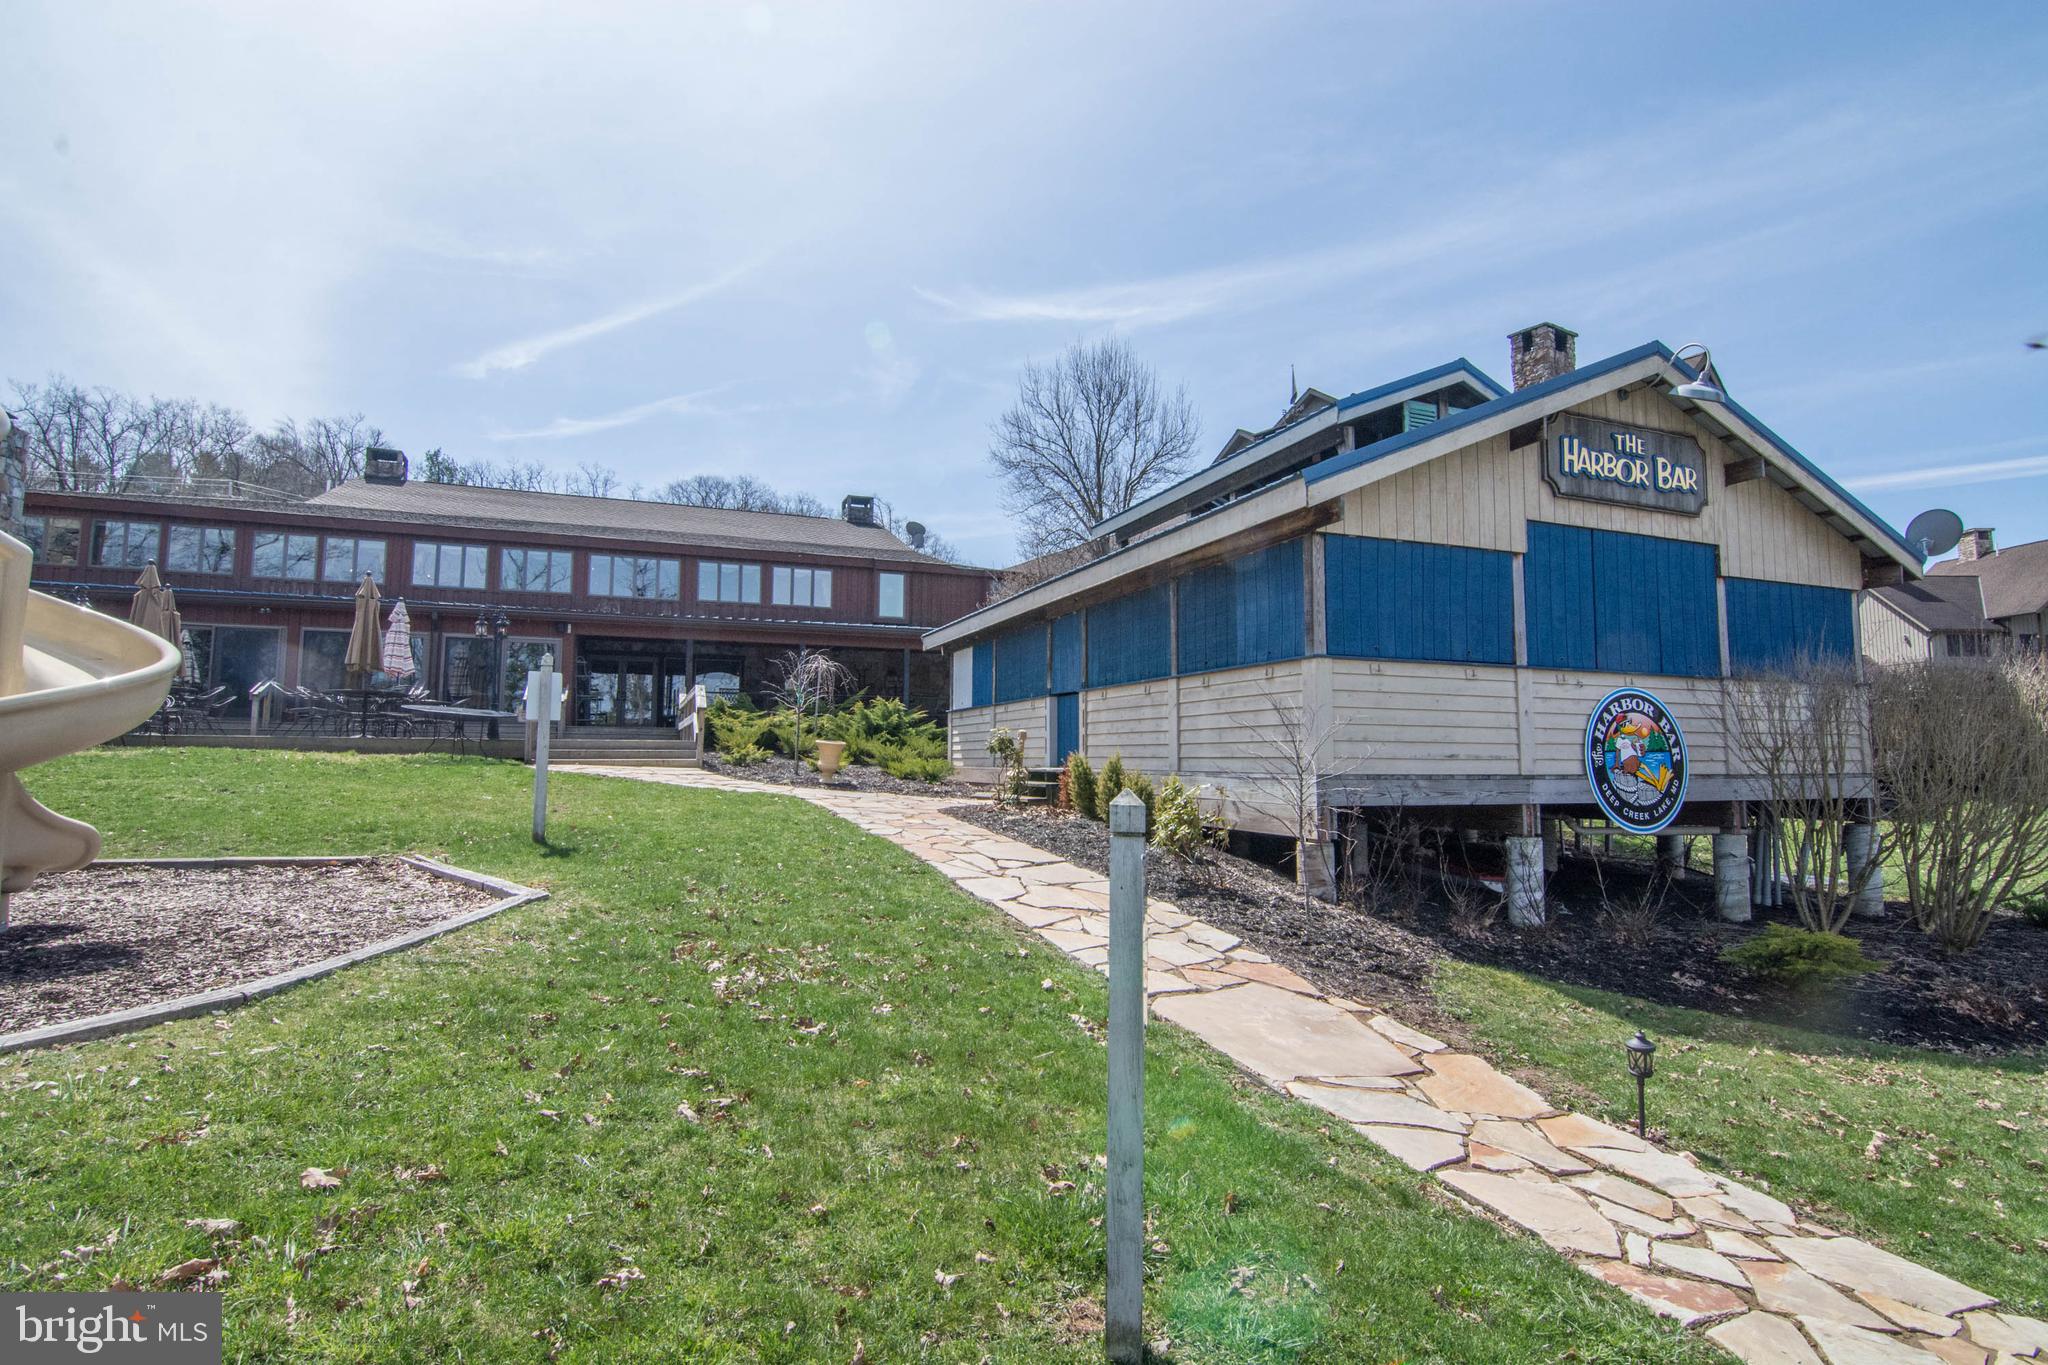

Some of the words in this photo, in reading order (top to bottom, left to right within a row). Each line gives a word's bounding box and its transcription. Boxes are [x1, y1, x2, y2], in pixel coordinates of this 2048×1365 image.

[1563, 437, 1650, 487] HARBOR
[1656, 456, 1698, 491] BAR
[1613, 433, 1646, 455] THE
[1595, 698, 1655, 740] HARBOR
[1658, 717, 1681, 762] BAR
[1602, 783, 1620, 806] DEEP
[1623, 808, 1650, 820] CREEK
[1671, 779, 1680, 795] MD
